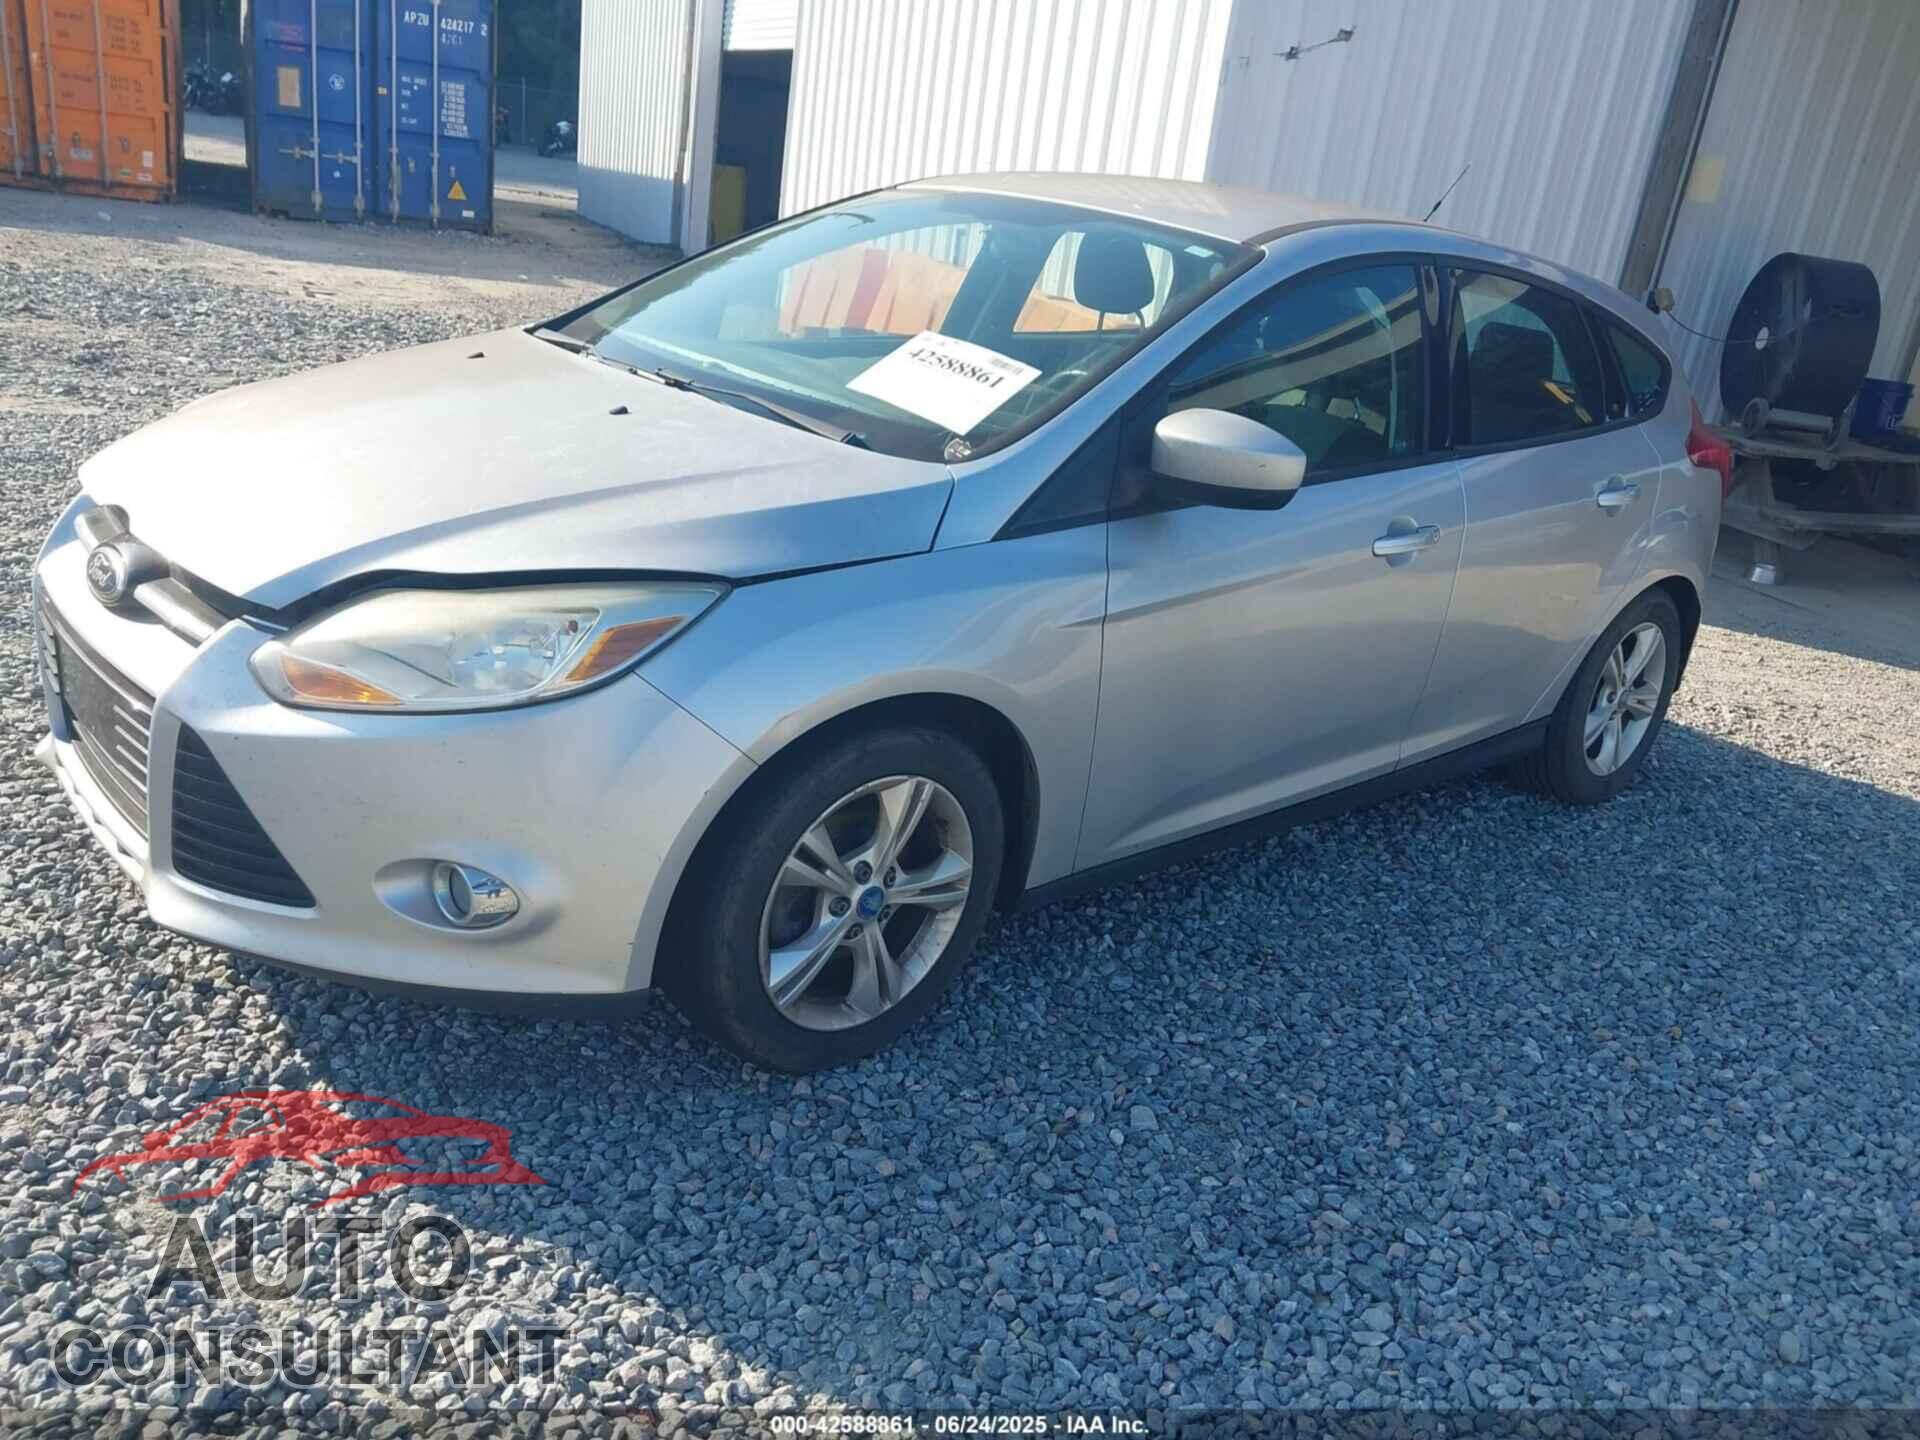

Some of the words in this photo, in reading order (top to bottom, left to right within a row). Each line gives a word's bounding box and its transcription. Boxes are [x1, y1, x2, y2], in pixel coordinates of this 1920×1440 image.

[404, 10, 430, 27] APZU
[440, 17, 475, 34] 424217
[908, 347, 1005, 388] 42588861
